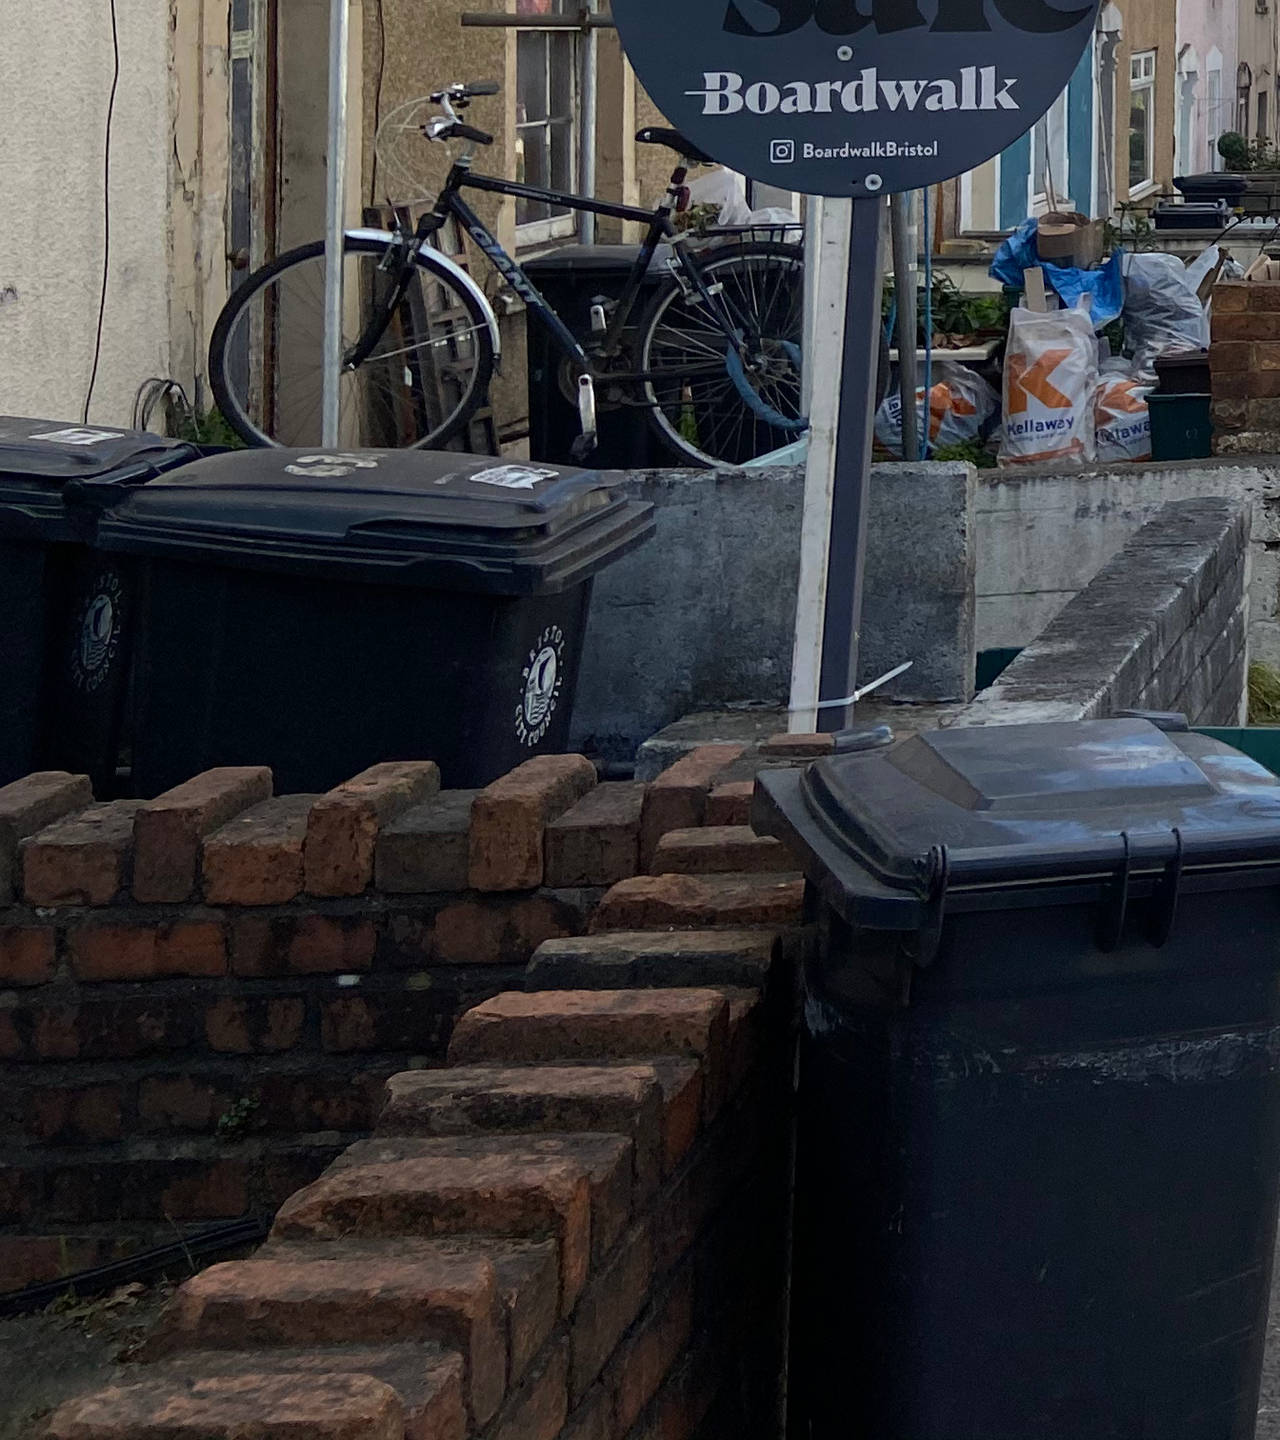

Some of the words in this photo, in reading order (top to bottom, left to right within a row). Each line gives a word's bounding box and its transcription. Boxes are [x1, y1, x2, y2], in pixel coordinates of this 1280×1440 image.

[685, 66, 1020, 116] Boardwalk
[803, 140, 938, 159] BoardwalkBristol
[468, 225, 543, 305] GIANT
[1007, 416, 1074, 436] Kellaway
[521, 625, 565, 679] BRISTOL
